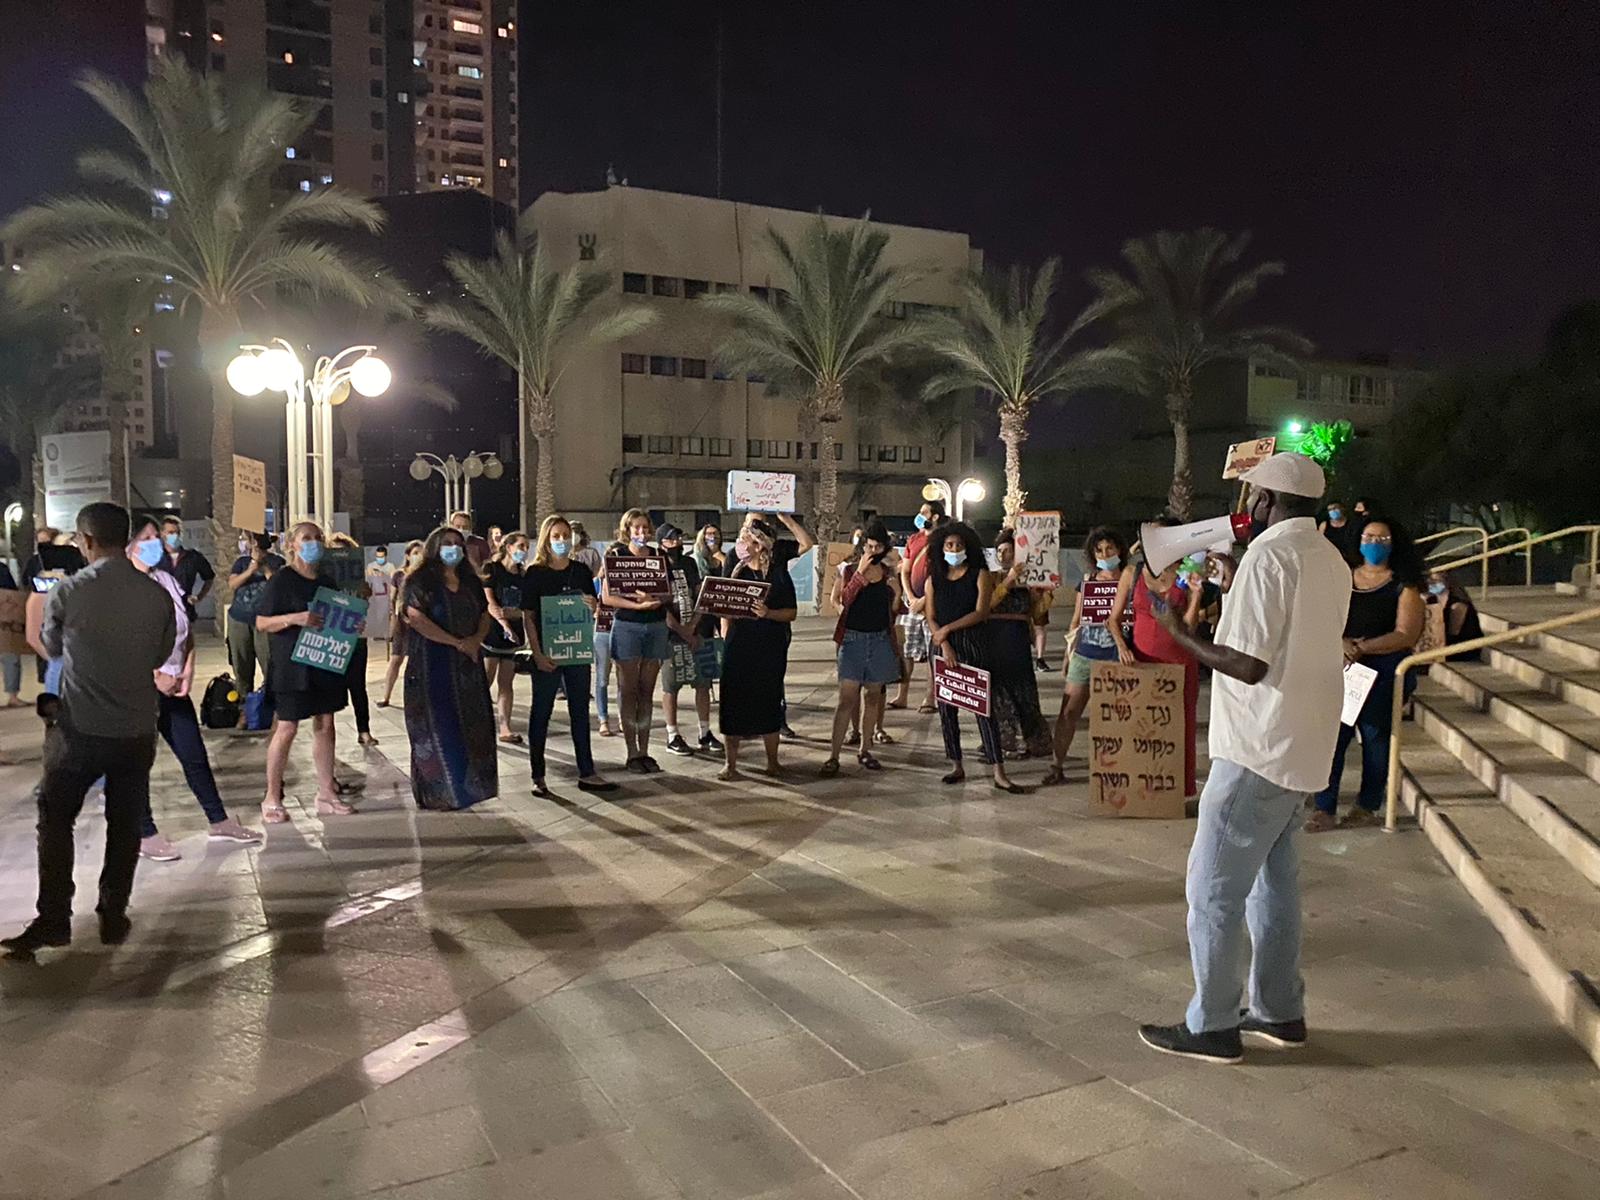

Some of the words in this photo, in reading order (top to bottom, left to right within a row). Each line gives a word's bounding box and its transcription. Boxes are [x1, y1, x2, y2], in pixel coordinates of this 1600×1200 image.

[616, 561, 645, 569] שותקות
[1026, 550, 1048, 566] לא
[302, 631, 352, 656] לאלימות
[296, 645, 326, 664] נשים
[328, 654, 346, 669] נגד
[1155, 677, 1177, 693] מי
[1100, 703, 1132, 722] נשים
[1146, 705, 1172, 727] נגד
[1132, 737, 1176, 760] מקומו
[1091, 771, 1130, 804] חשוך
[1137, 773, 1177, 792] בבור
